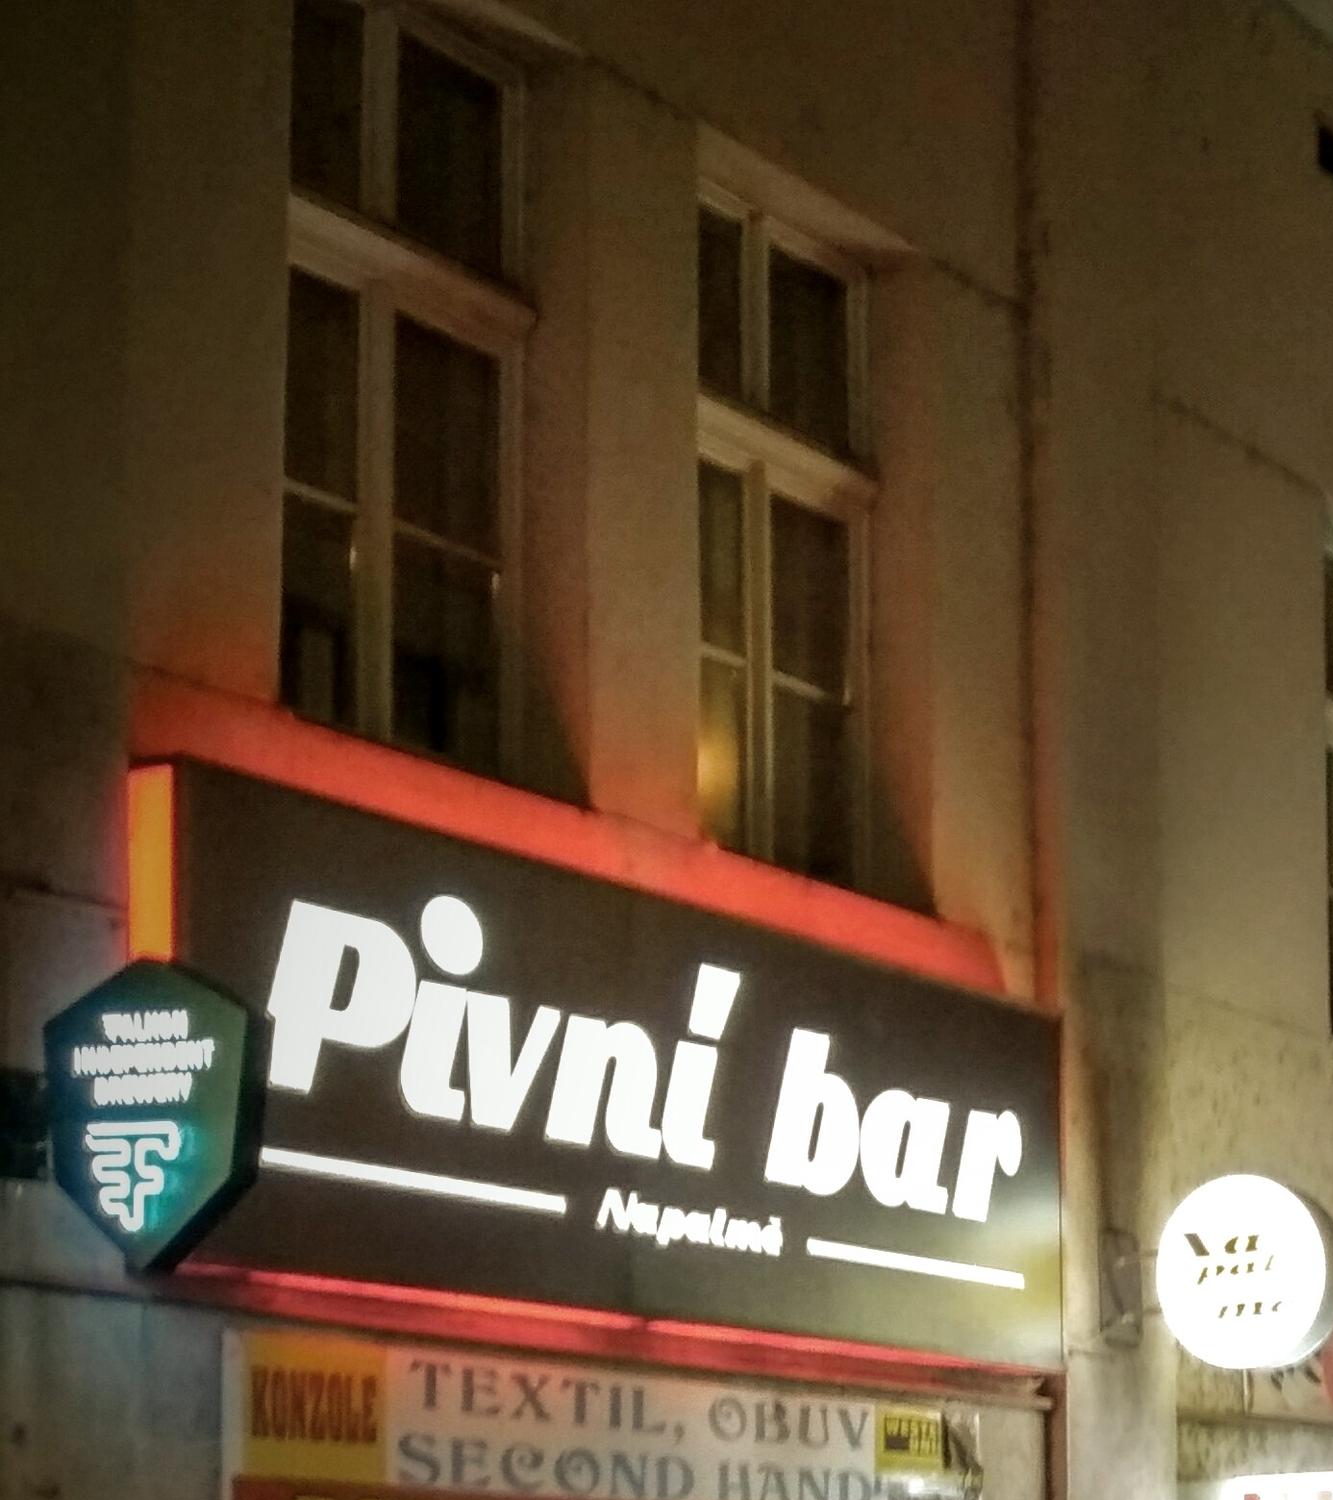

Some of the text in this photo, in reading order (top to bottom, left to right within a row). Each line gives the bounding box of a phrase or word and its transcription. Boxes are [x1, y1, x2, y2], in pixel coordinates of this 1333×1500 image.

[764, 1026, 1024, 1227] bar
[250, 1363, 379, 1444] KONZOLE
[409, 1357, 870, 1451] TEXTIL, OBUV
